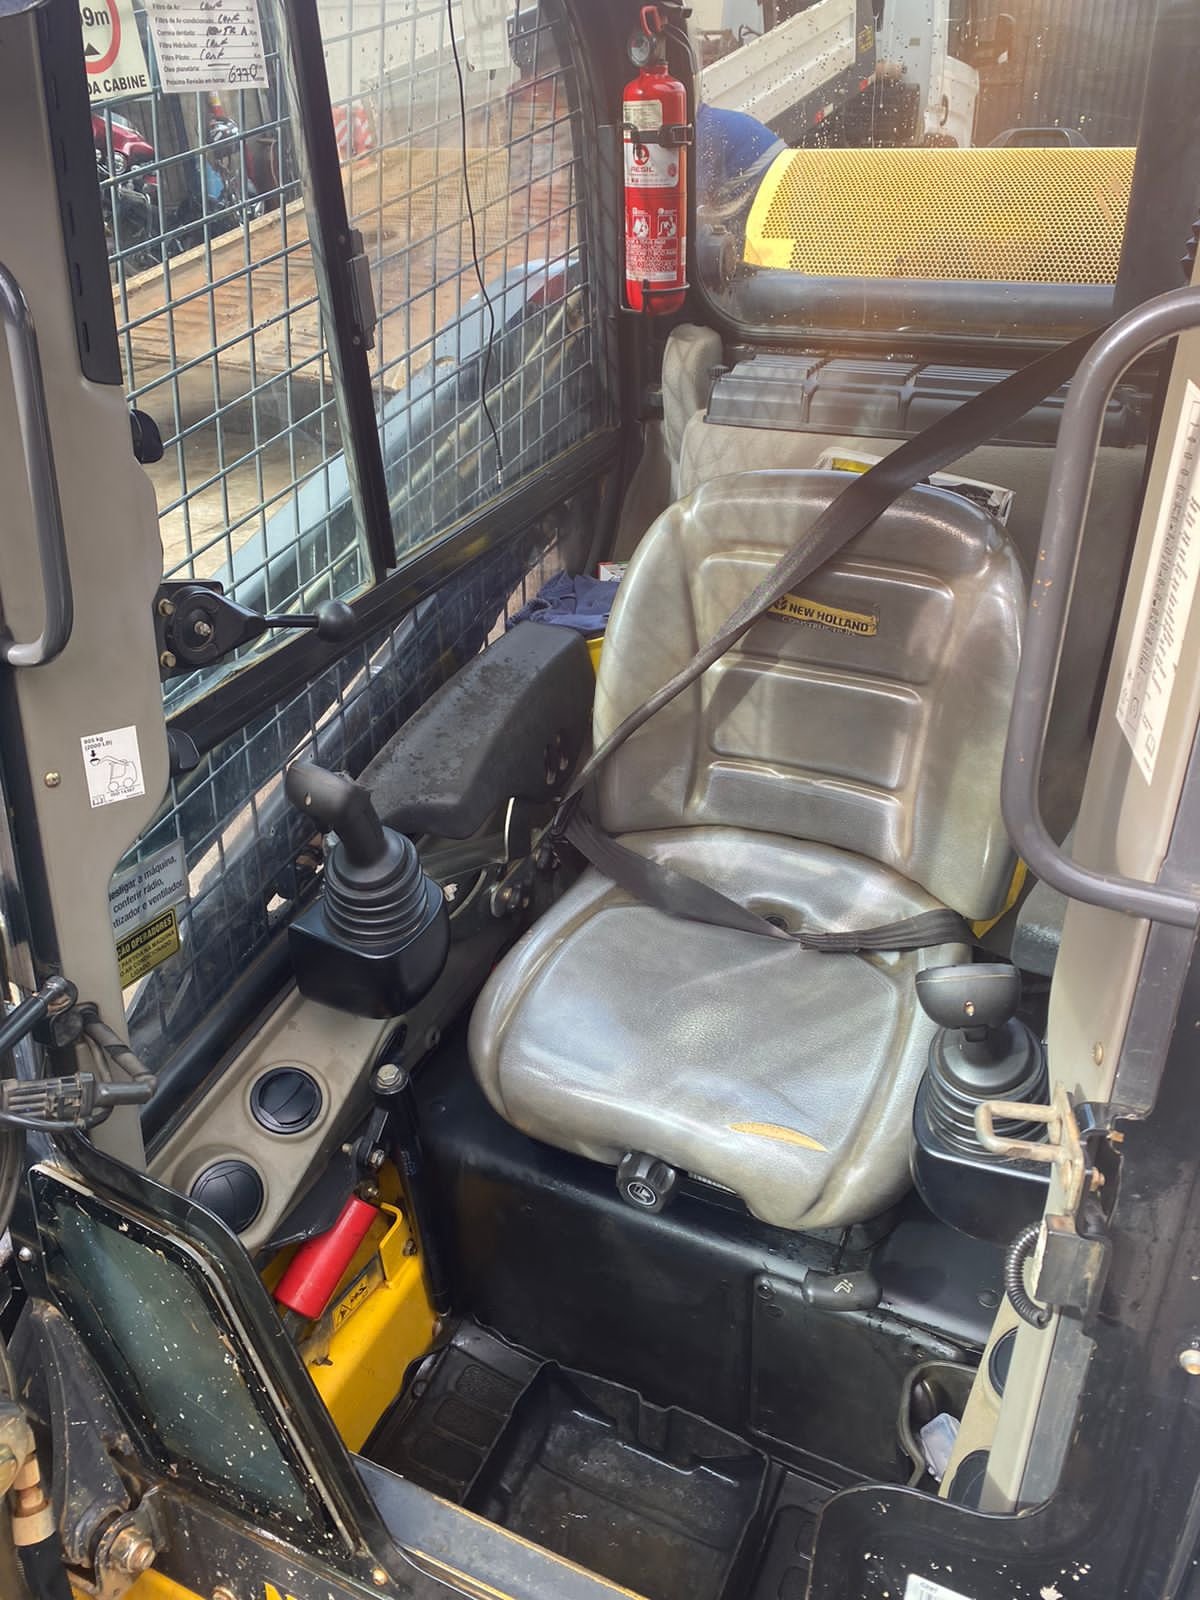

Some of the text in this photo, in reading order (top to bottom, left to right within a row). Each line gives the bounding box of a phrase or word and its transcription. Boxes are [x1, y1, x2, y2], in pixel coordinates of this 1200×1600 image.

[103, 74, 147, 92] CABINE
[788, 603, 815, 618] NEW
[816, 610, 869, 632] HOLLAND
